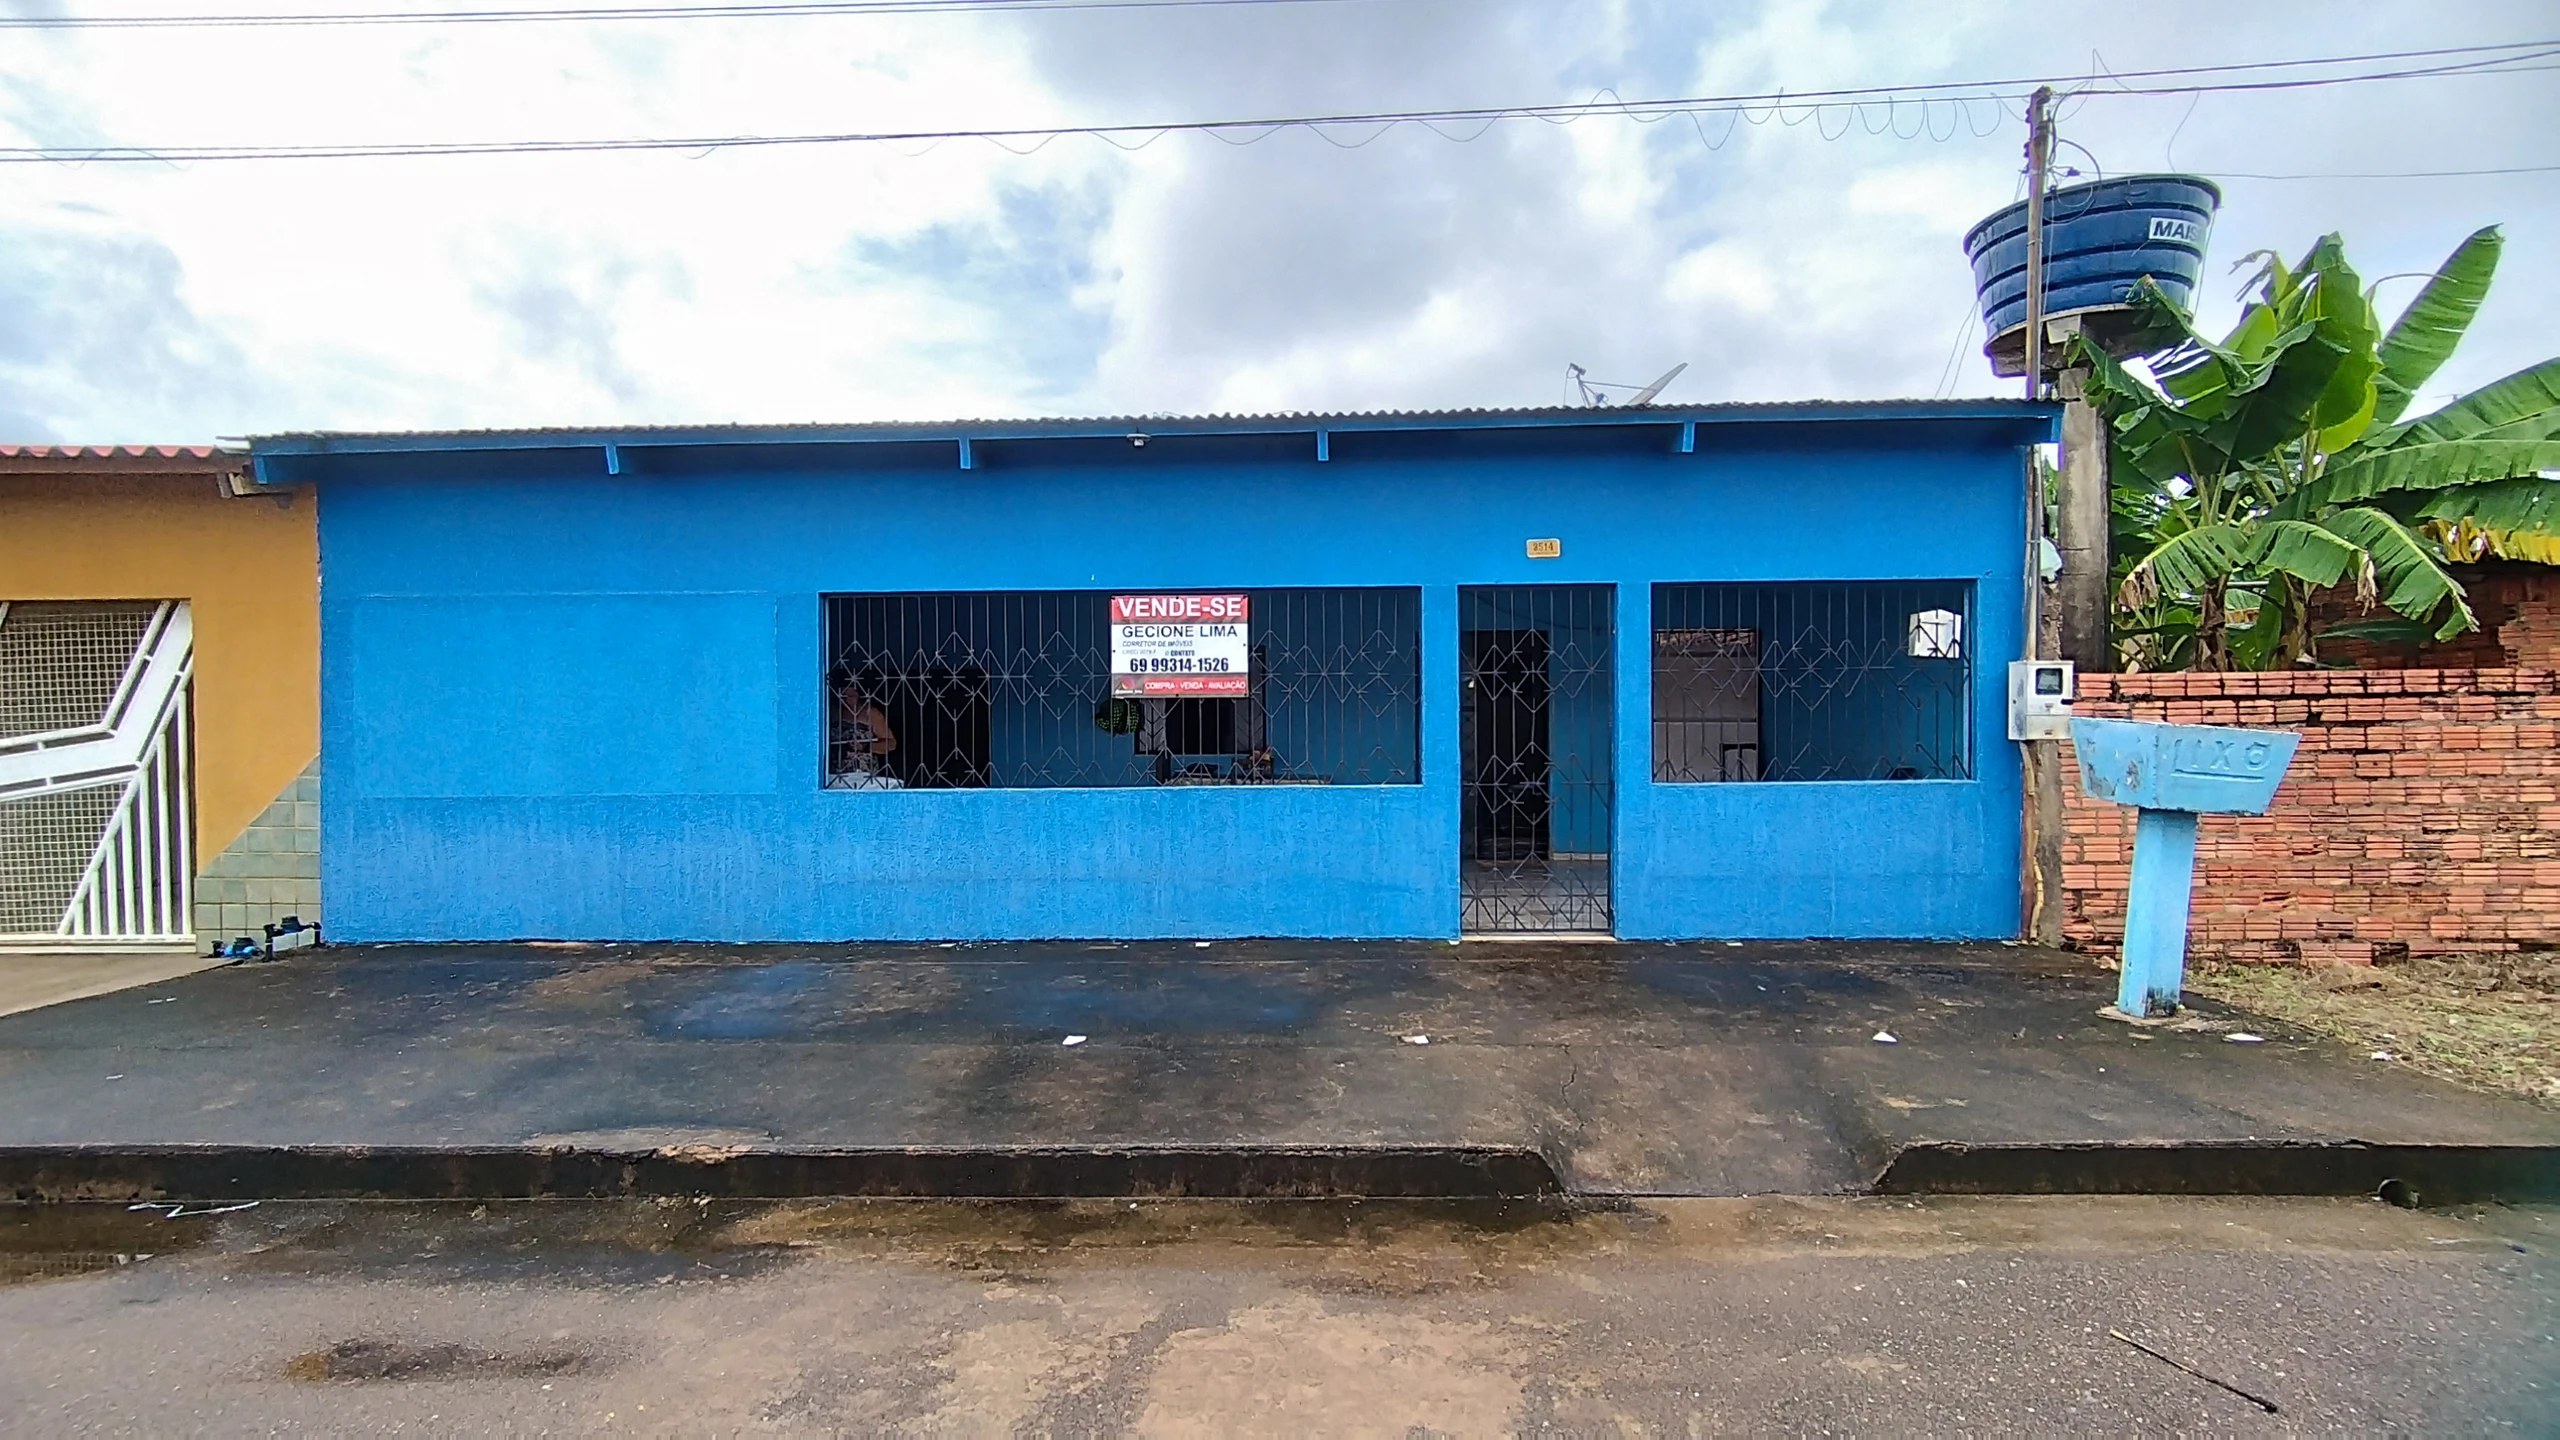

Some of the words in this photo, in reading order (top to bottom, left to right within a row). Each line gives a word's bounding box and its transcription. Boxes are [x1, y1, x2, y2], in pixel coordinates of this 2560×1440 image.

[1118, 597, 1242, 617] VENDE-SE
[1122, 625, 1194, 638] GECIONE
[1200, 625, 1238, 638] LIMA
[1122, 640, 1156, 648] CORRETOR
[1157, 640, 1167, 648] DE
[1168, 639, 1193, 647] IMÓVEIS
[1130, 658, 1147, 672] 69
[1151, 657, 1229, 672] 99314-1526
[1144, 680, 1176, 690] COMPRA
[1179, 680, 1204, 690] VENDA
[1208, 679, 1246, 691] AVALIAÇÃO
